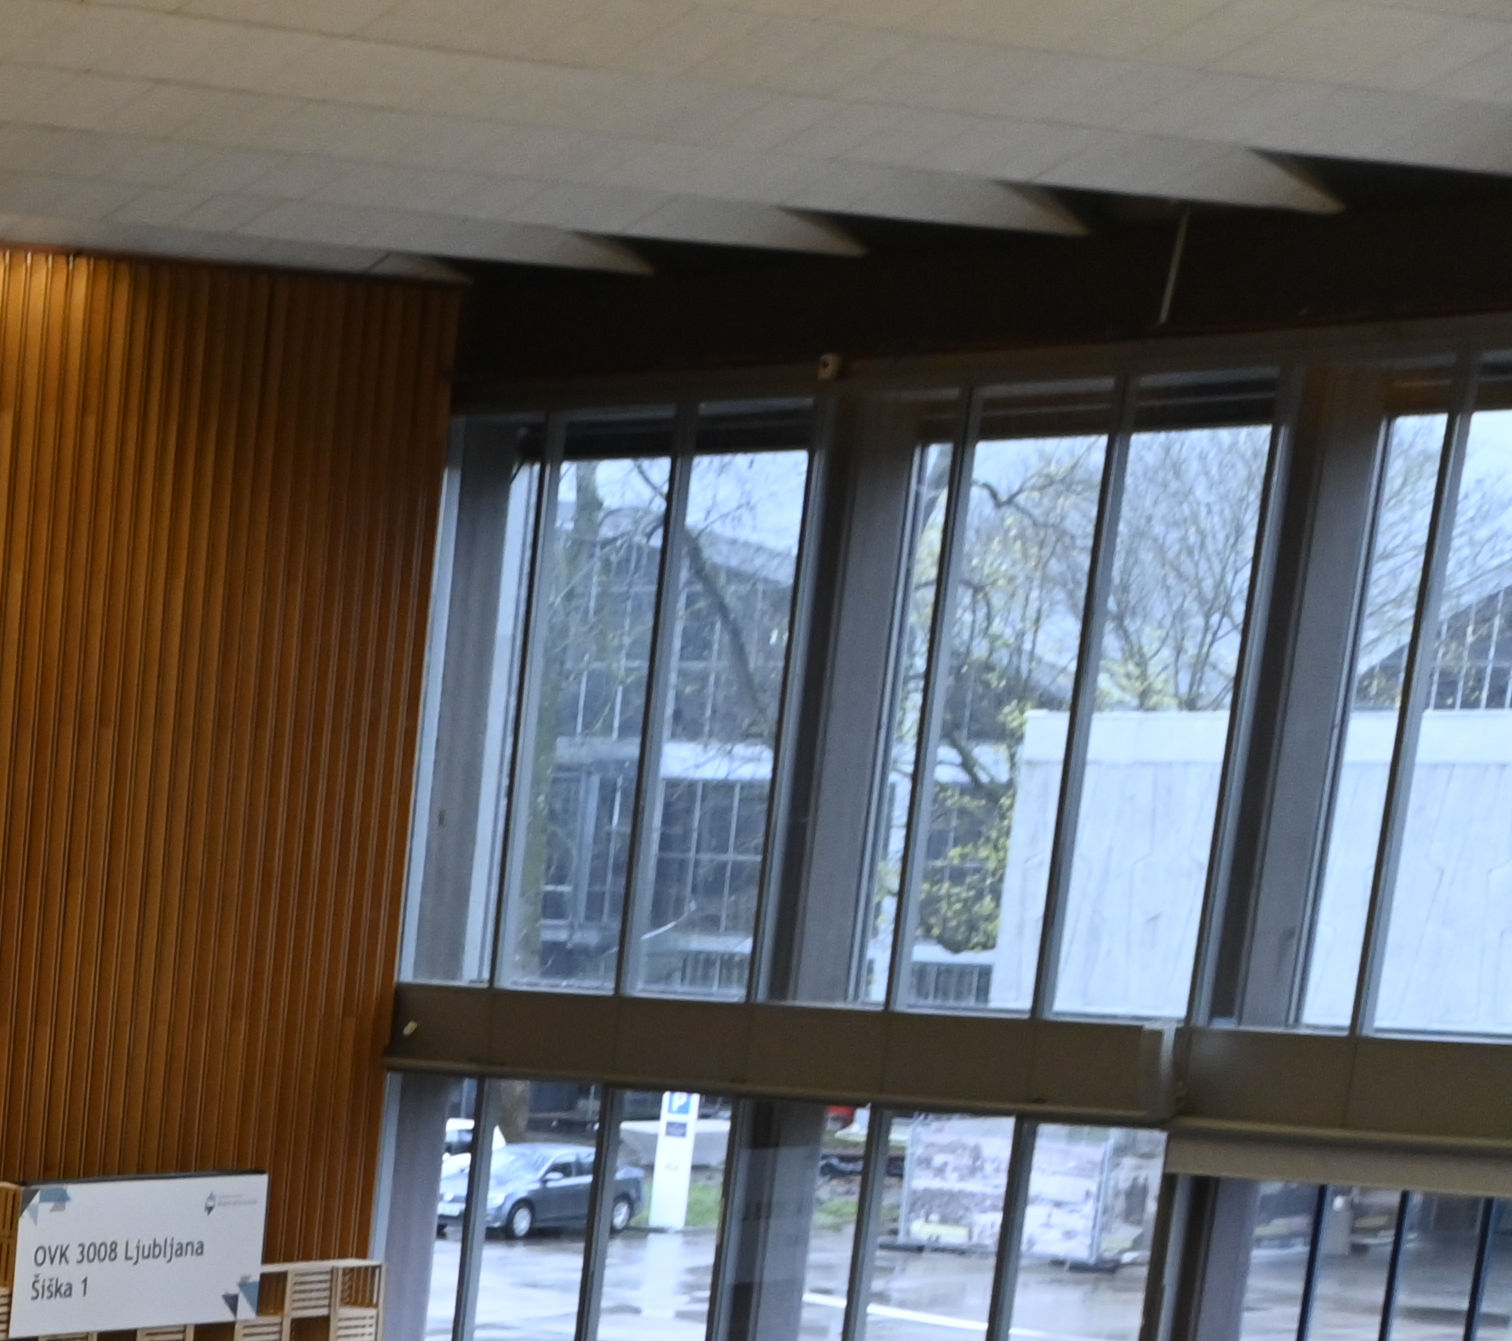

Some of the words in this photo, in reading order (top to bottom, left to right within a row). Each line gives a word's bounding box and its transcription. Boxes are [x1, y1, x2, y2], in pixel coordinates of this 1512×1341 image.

[33, 1243, 70, 1268] OVK
[75, 1240, 118, 1265] 3008
[124, 1237, 205, 1266] Ljubljana
[30, 1273, 73, 1301] Šiška
[81, 1276, 88, 1297] 1
